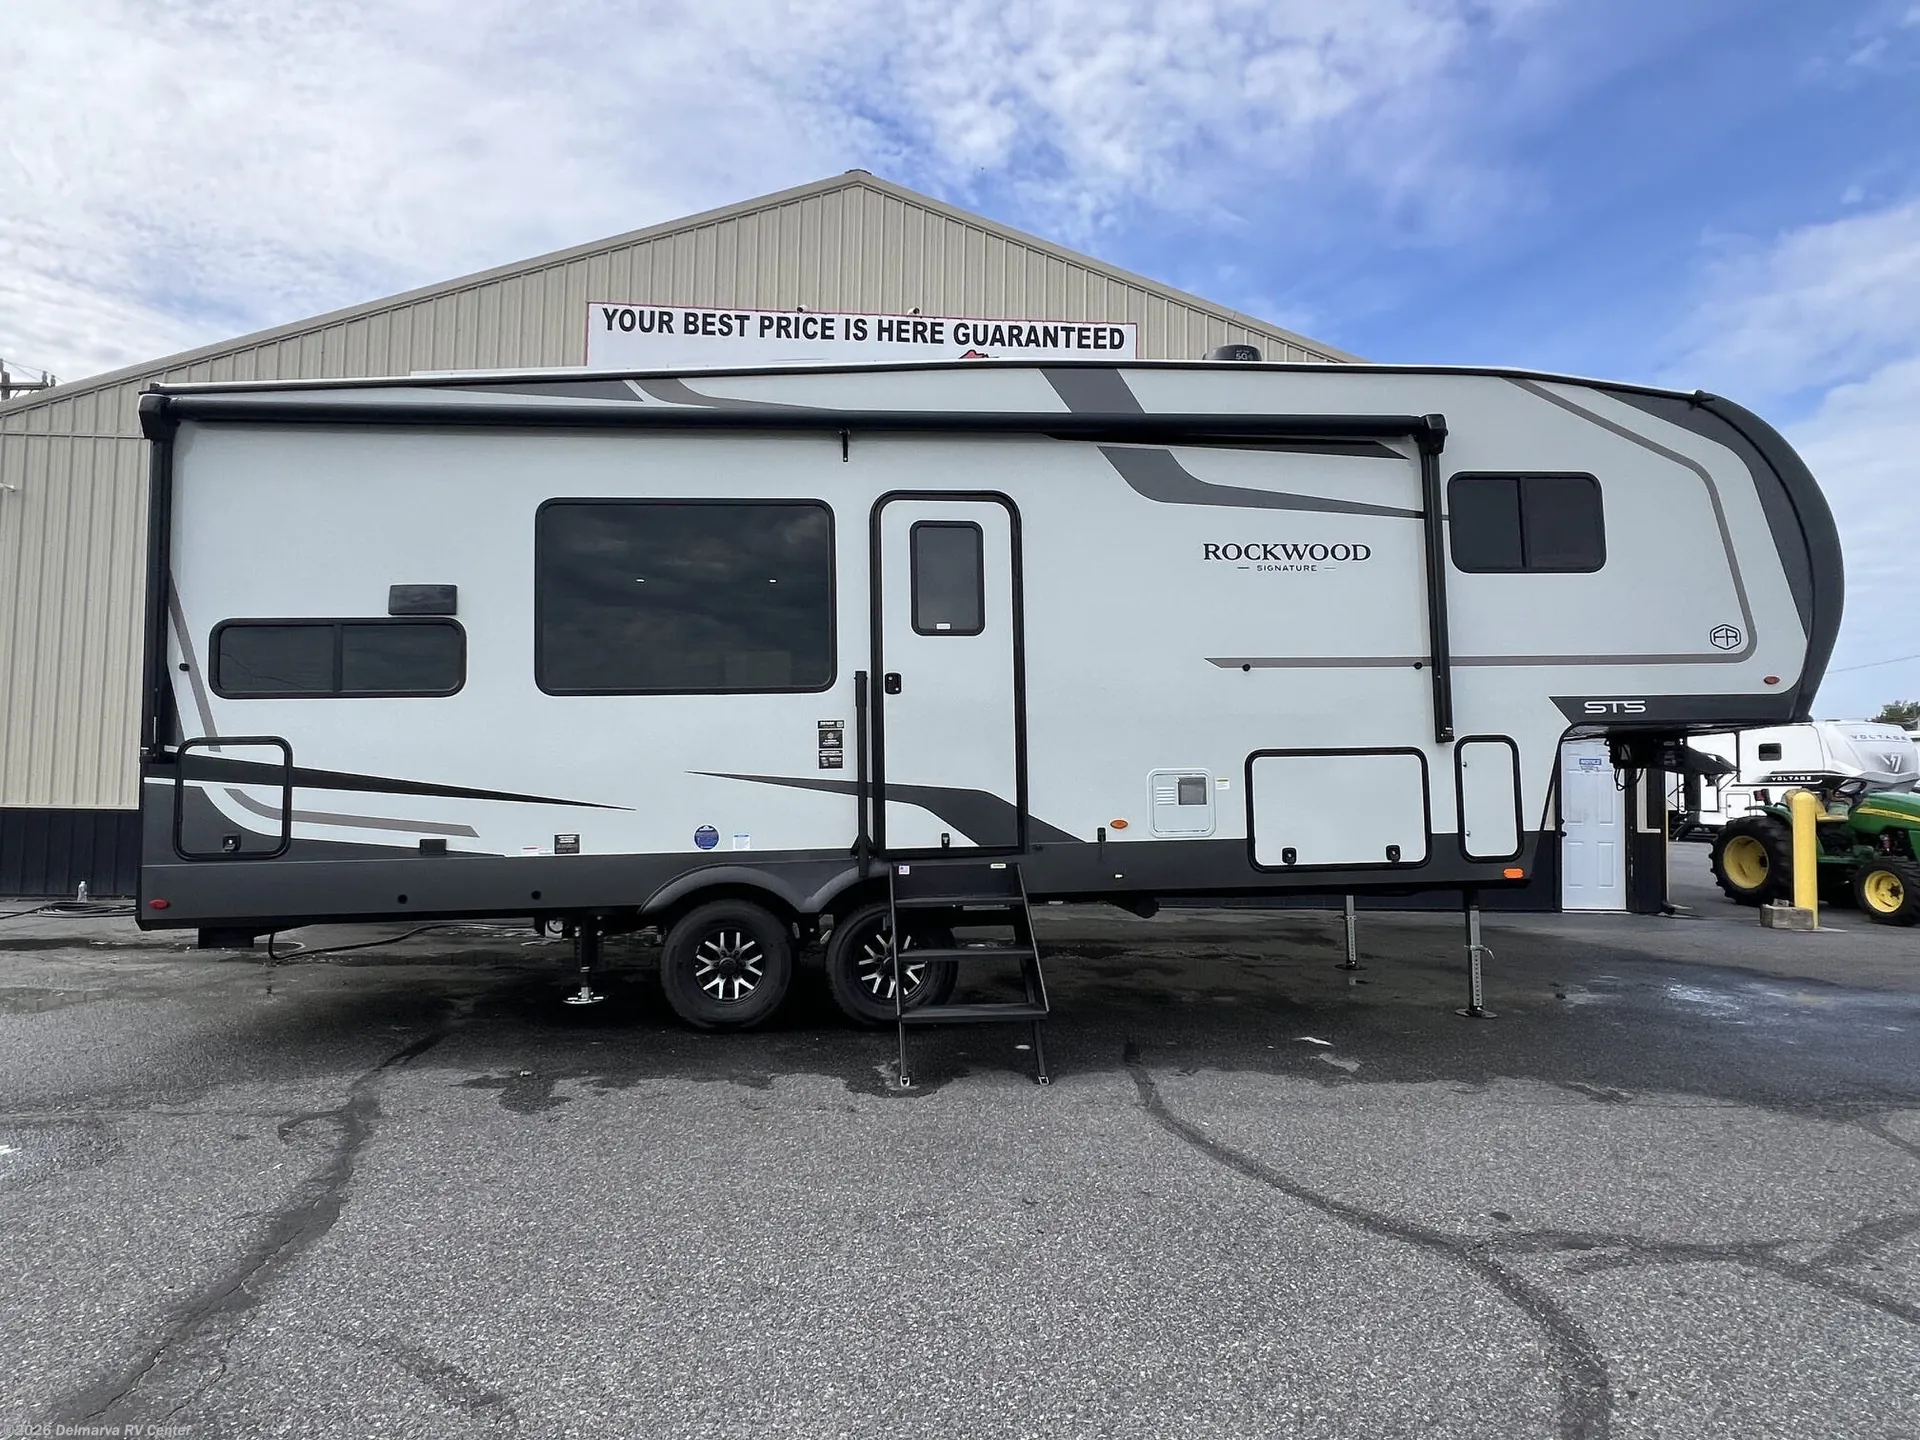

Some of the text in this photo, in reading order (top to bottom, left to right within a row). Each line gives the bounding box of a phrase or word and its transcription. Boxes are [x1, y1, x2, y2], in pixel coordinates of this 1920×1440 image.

[602, 307, 1125, 350] YOUR BEST PRICE IS HERE GUARANTEED
[1203, 543, 1372, 561] ROCKWOOD
[1256, 564, 1318, 572] SIGNATURE
[1584, 700, 1647, 713] STS
